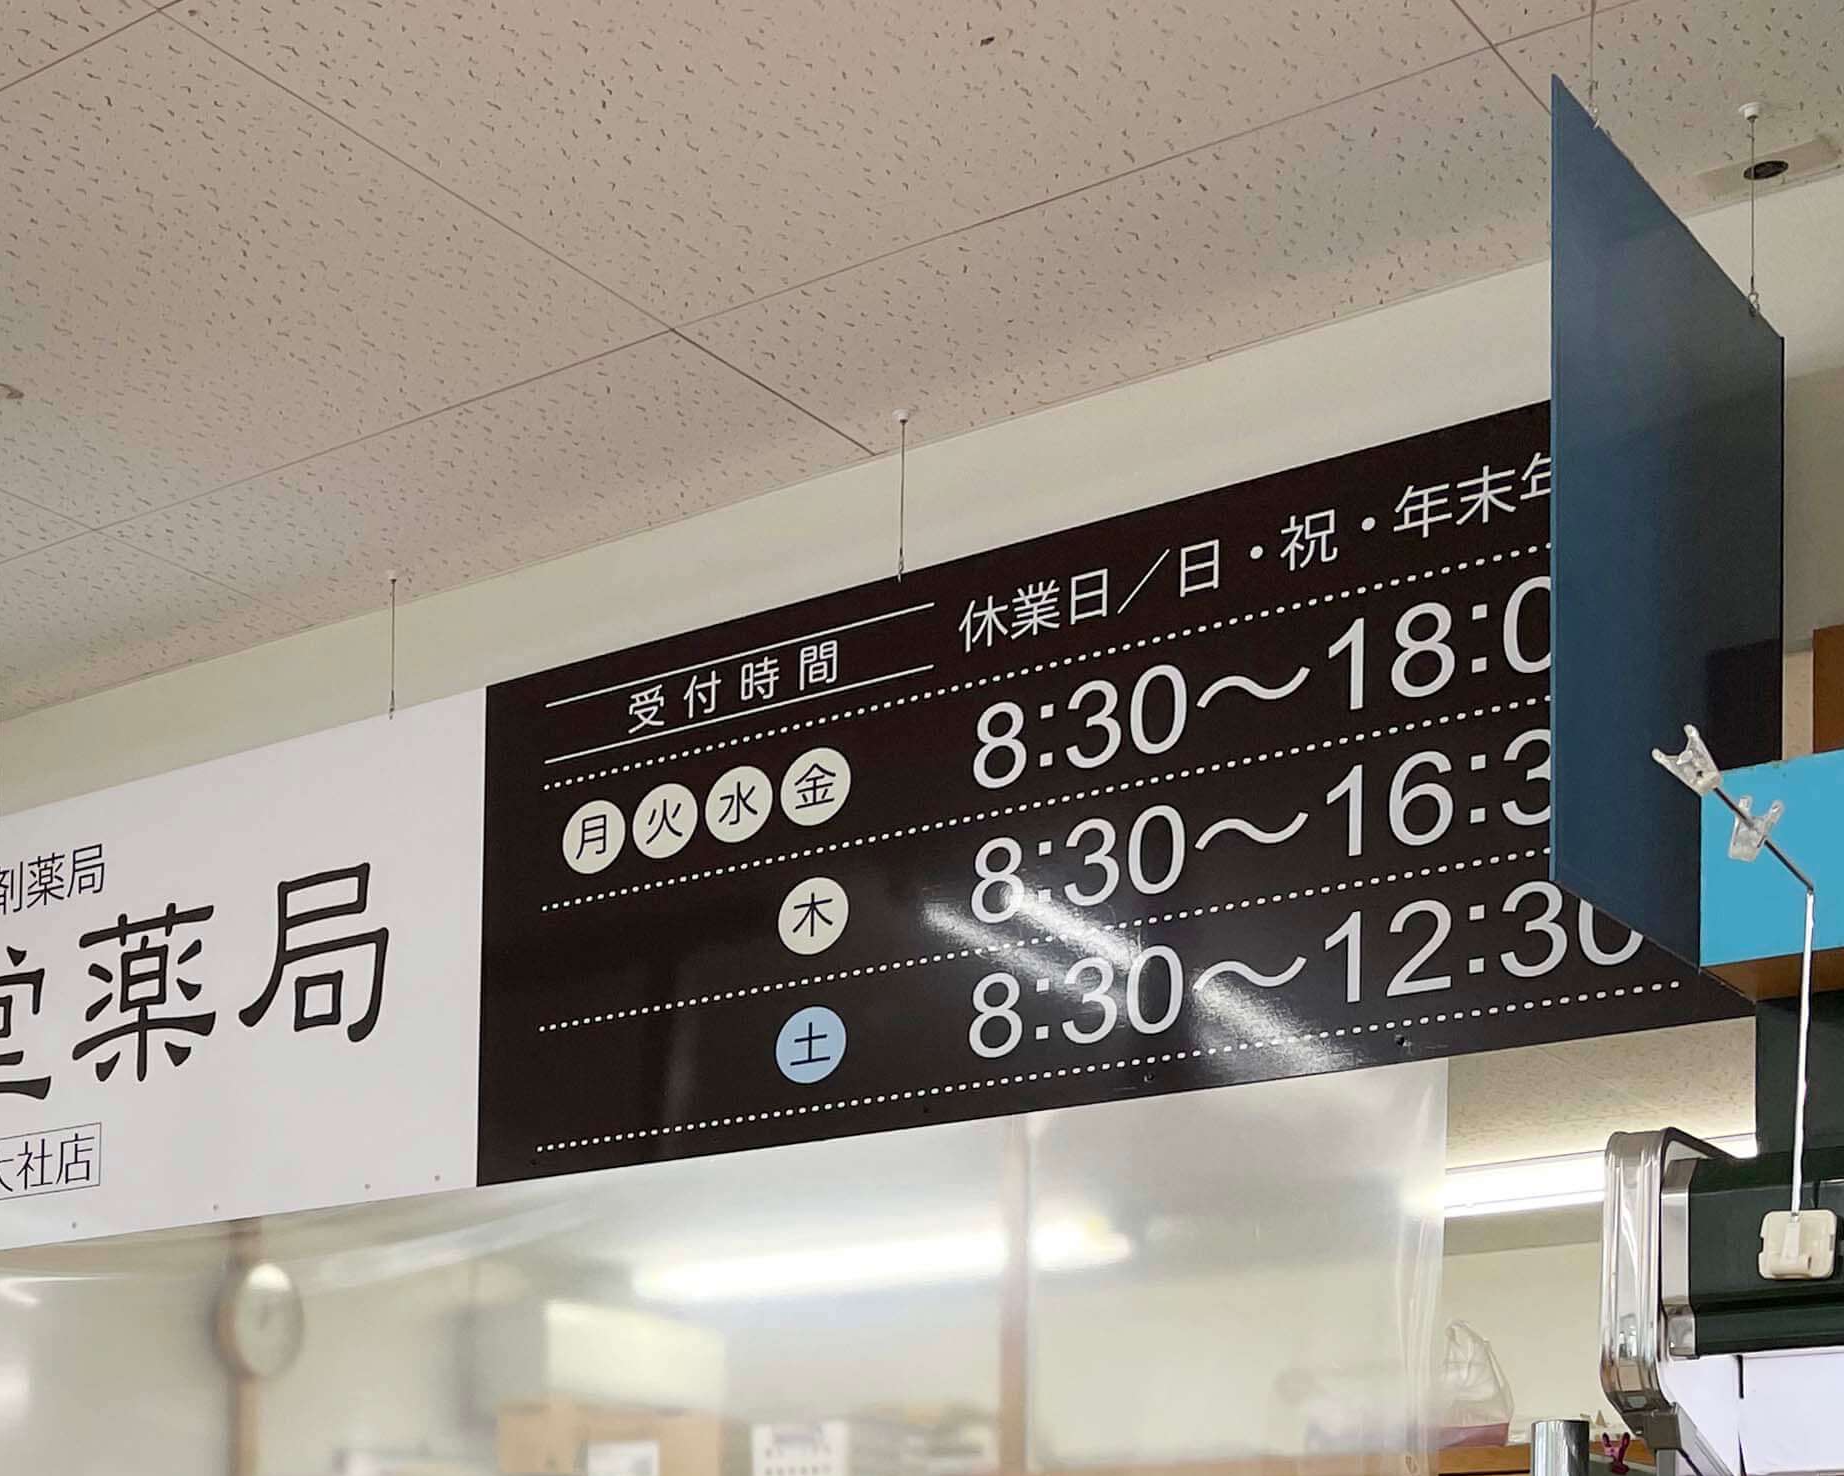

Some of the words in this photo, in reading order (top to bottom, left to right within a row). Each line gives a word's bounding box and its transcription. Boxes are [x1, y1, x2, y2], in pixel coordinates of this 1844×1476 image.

[626, 645, 842, 735] 受付時間
[790, 893, 838, 942] 木
[790, 1023, 838, 1067] 土
